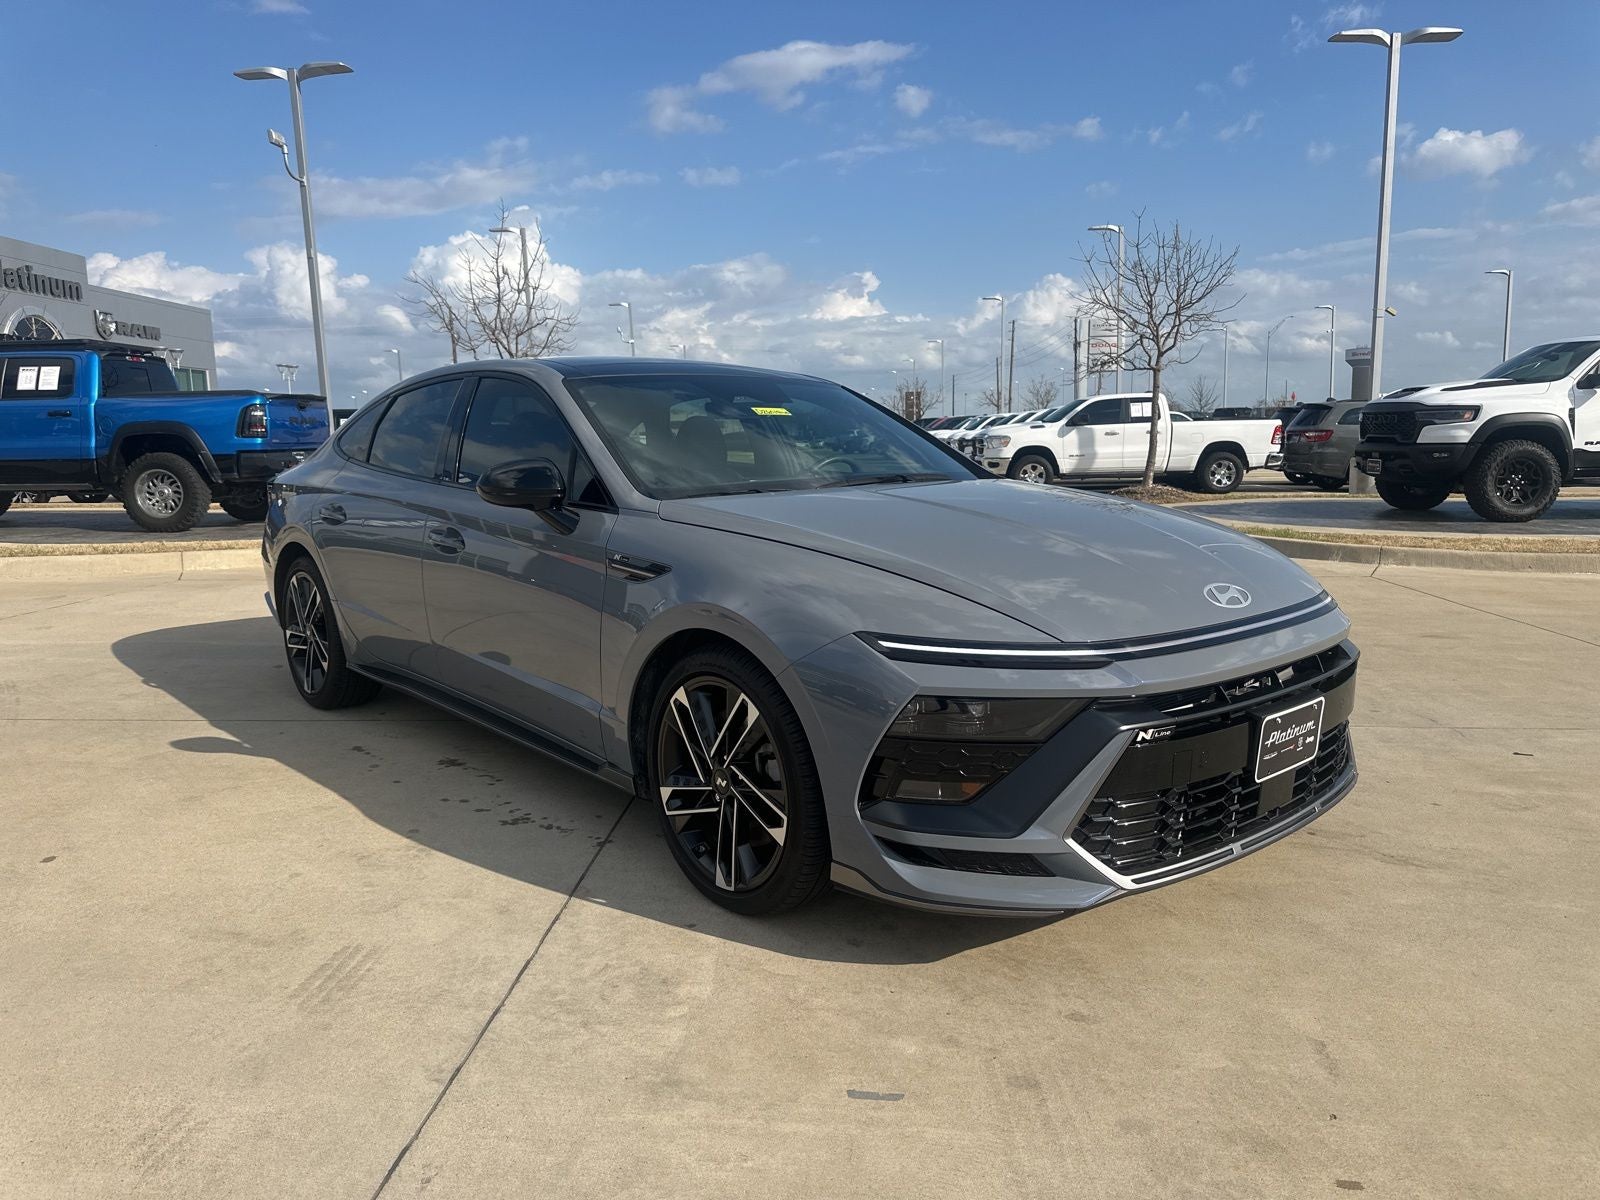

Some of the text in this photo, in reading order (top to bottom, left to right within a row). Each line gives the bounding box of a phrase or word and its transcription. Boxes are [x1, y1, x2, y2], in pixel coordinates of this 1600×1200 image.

[115, 320, 161, 341] RAM
[1136, 728, 1172, 742] N Line
[1264, 720, 1316, 747] Platinum
